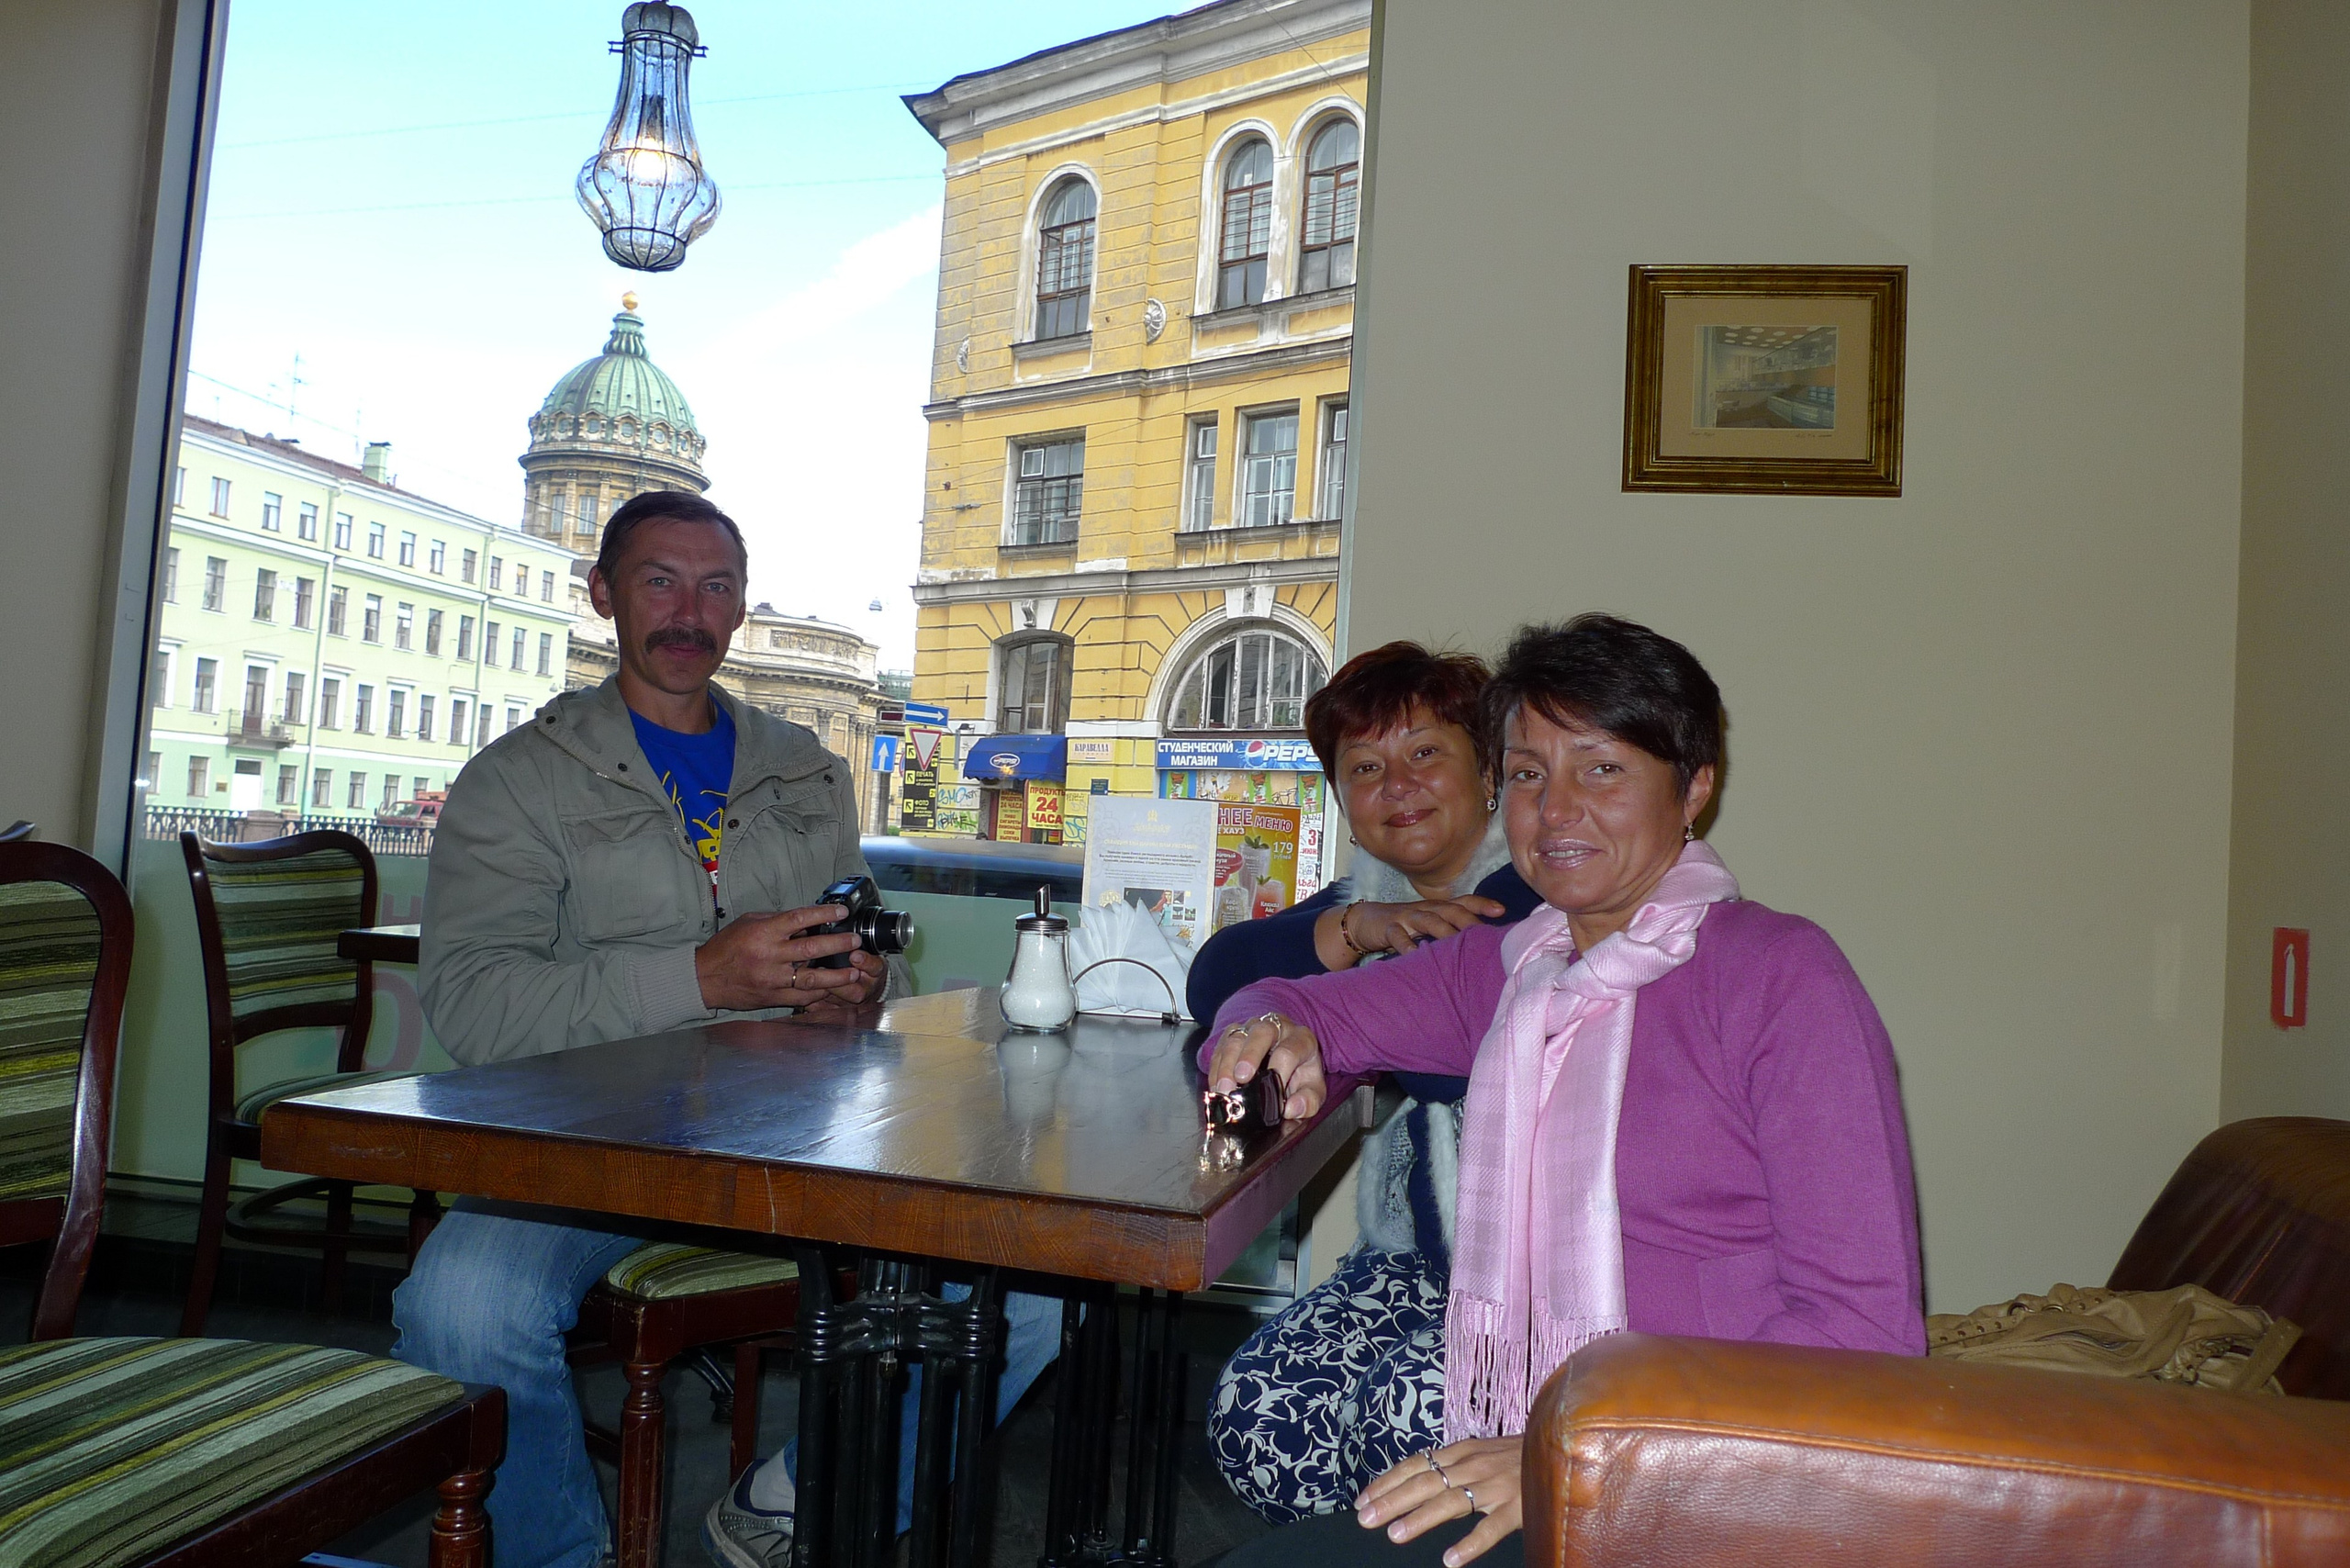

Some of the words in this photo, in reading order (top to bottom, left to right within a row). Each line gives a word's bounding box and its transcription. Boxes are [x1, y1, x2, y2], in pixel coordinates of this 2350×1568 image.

[1074, 743, 1109, 752] КАРАВЕЛЛА
[1158, 740, 1234, 754] СТУДЕНЧЕСКИЙ
[1262, 745, 1320, 762] PEPS
[1170, 755, 1218, 767] МАГАЗИН
[1030, 787, 1065, 796] ПРОДУКТЫ
[1035, 796, 1058, 812] 24
[1031, 812, 1063, 824] ЧАСА
[1218, 808, 1254, 826] НЕЕ
[1255, 815, 1293, 833] МЕНЮ
[1308, 829, 1316, 846] 3
[1273, 841, 1293, 854] 179
